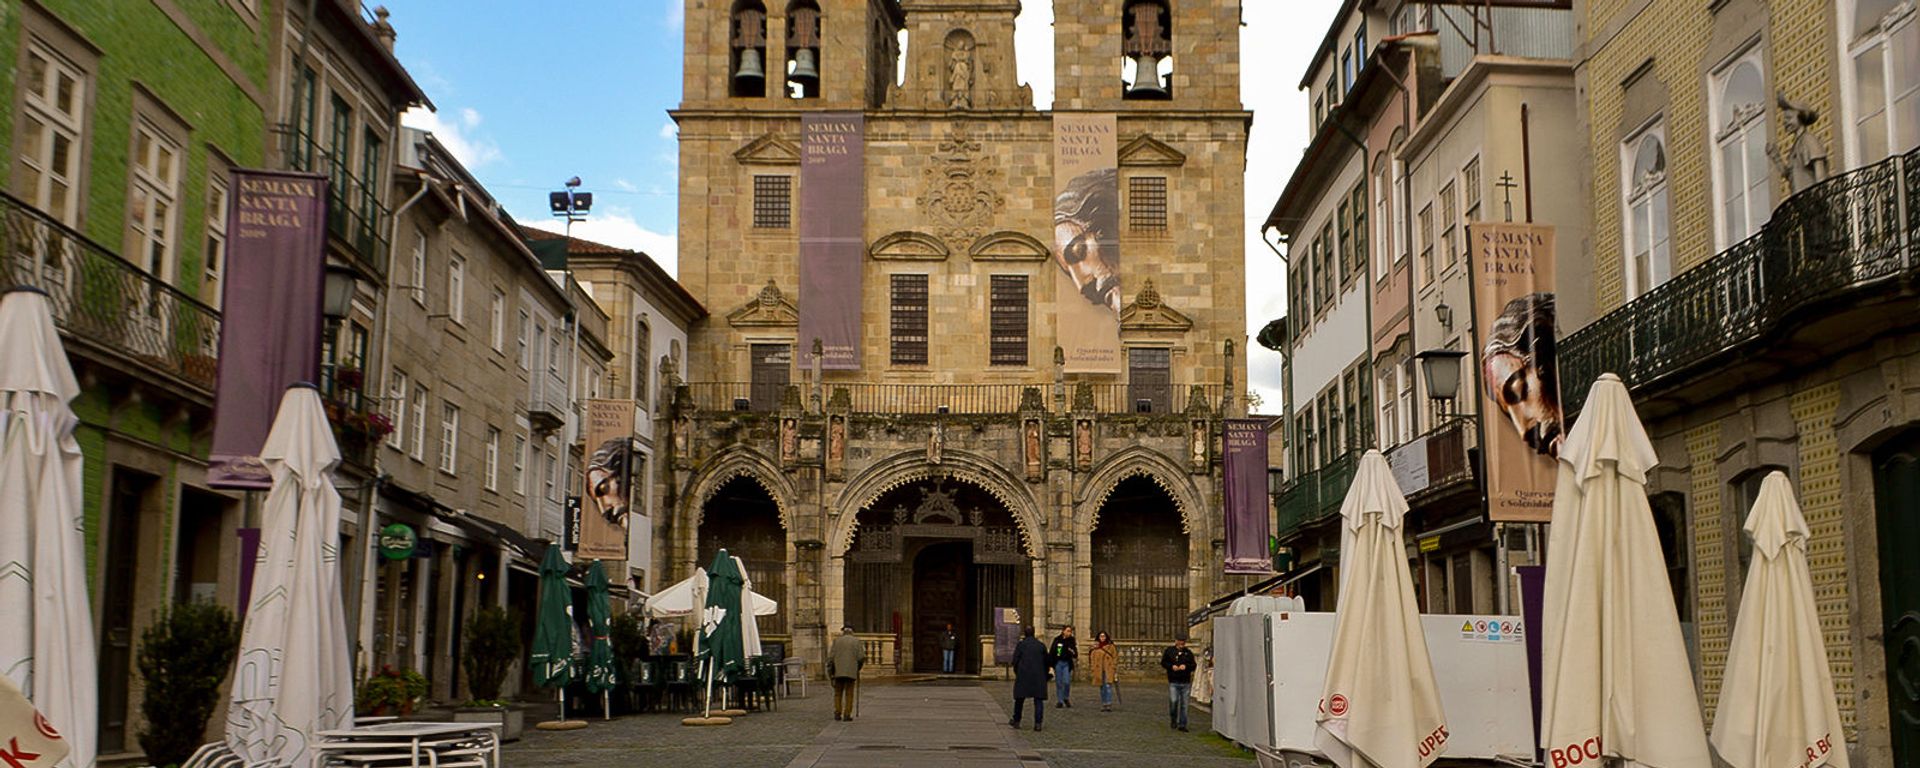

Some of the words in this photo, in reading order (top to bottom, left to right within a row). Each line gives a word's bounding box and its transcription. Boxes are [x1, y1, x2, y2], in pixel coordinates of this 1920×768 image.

[807, 123, 856, 133] SEMANA
[1060, 124, 1110, 134] SEMANA
[807, 134, 845, 144] SANTA
[1060, 135, 1099, 145] SANTA
[808, 145, 848, 155] BRAGA
[1061, 147, 1102, 156] BRAGA
[239, 180, 316, 198] SEMANA
[239, 195, 298, 213] SANTA
[239, 211, 301, 229] BRAGA
[1482, 231, 1543, 246] SEMANA
[1483, 247, 1531, 260] SANTA
[1484, 261, 1536, 276] BRAGA
[592, 403, 628, 412] SEMANA
[592, 411, 621, 420] SANTA
[592, 419, 622, 428] BRAGA
[1227, 422, 1264, 431] SEMANA
[1228, 431, 1256, 439] SANTA
[1228, 439, 1257, 447] BRAGA
[1514, 489, 1556, 501] Quaresm
[1418, 724, 1449, 762] UPE
